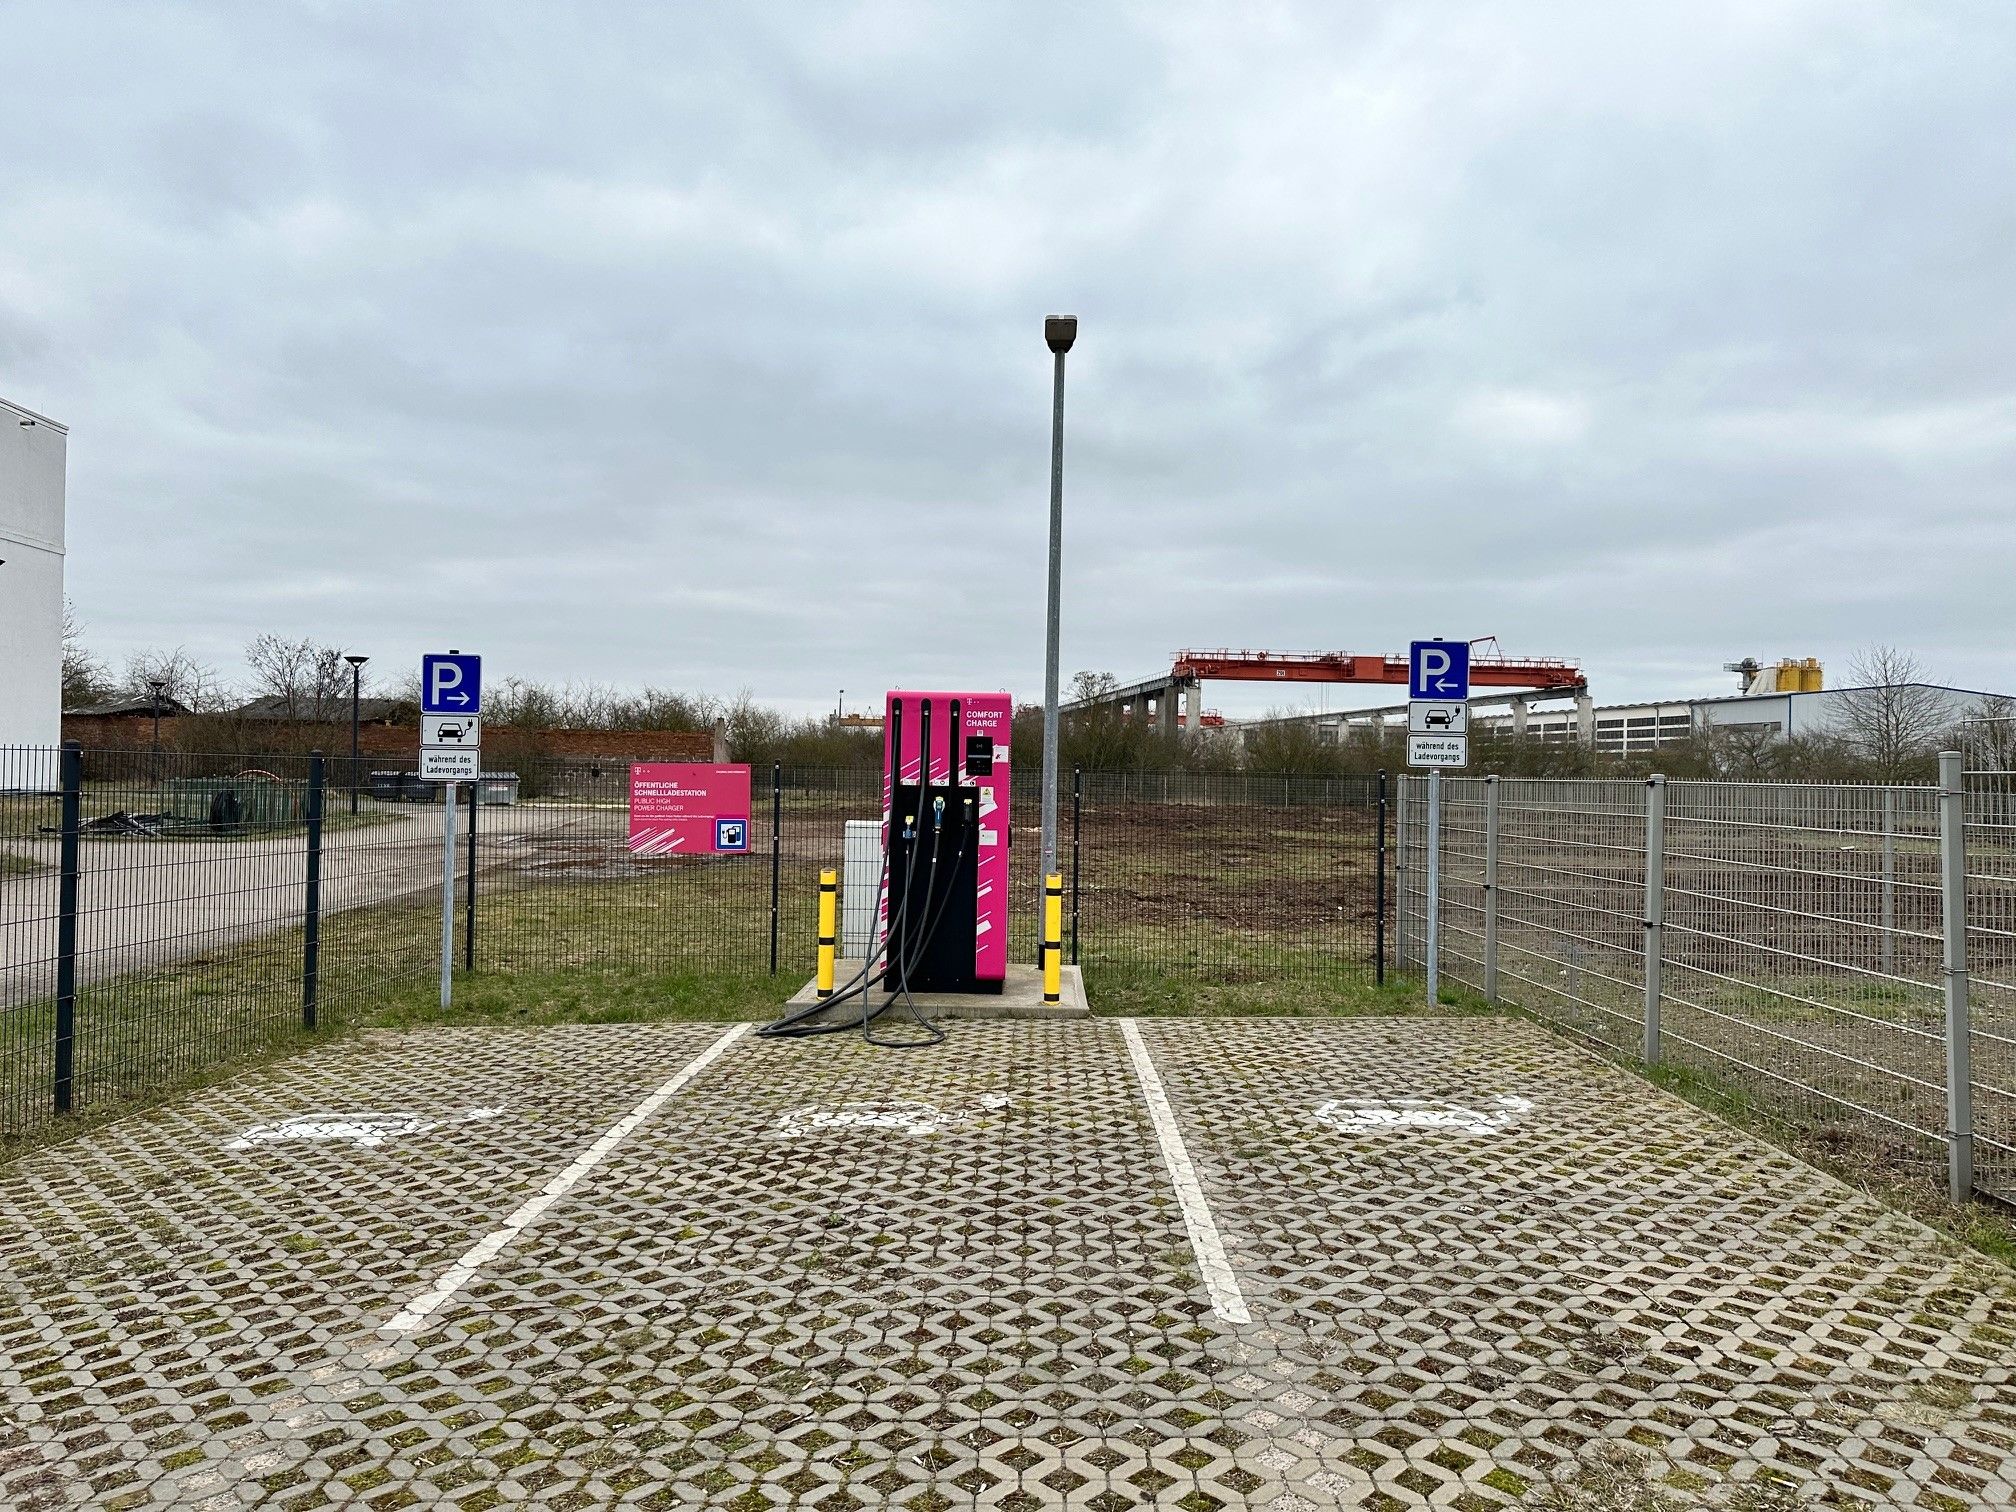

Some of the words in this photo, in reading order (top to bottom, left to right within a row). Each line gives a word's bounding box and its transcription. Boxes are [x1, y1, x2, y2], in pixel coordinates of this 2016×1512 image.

[1419, 648, 1451, 692] P
[431, 661, 463, 705] P
[966, 710, 1003, 719] COMFORT
[966, 719, 998, 728] CHARGE
[1416, 742, 1445, 750] während
[1447, 742, 1459, 750] des
[428, 755, 456, 763] während
[459, 755, 471, 763] des
[1414, 752, 1460, 762] Ladevorgangs
[426, 765, 473, 775] Ladevorgangs
[634, 781, 679, 789] ÖFFENTLICHE
[634, 789, 707, 797] SCHNELLLADESTATION
[656, 804, 684, 812] CHARGER
